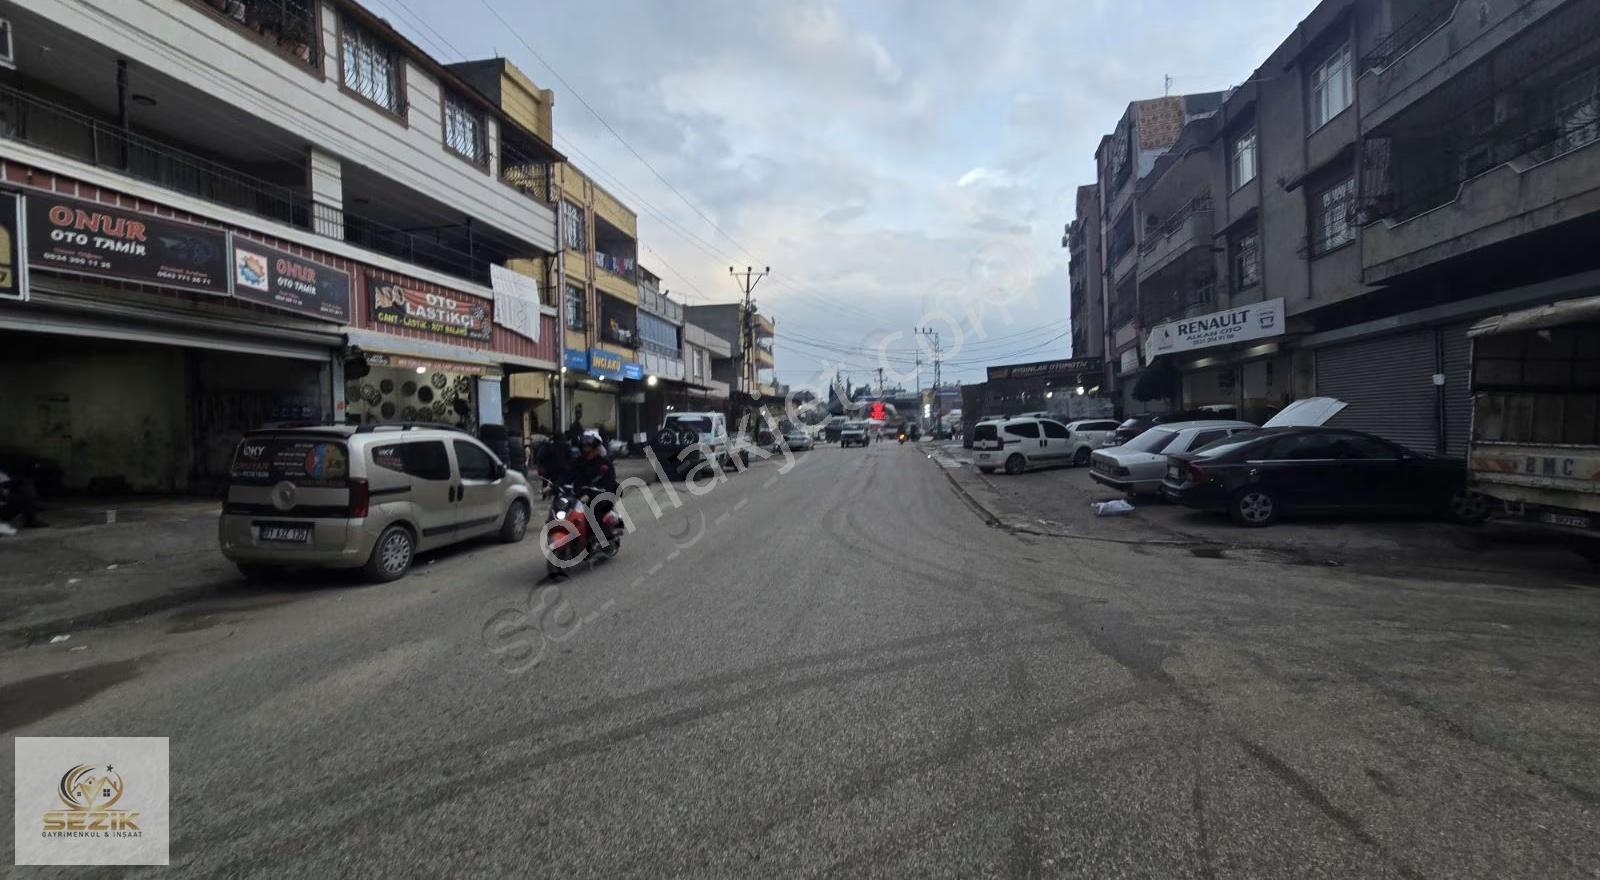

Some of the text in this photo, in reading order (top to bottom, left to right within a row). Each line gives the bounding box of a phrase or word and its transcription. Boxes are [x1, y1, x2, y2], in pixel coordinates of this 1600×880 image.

[49, 205, 147, 241] ONUR
[51, 229, 88, 245] OTO
[93, 236, 146, 256] TAMİR
[276, 259, 316, 284] ONUR
[277, 276, 293, 289] OTO
[426, 293, 457, 310] OTO
[1178, 309, 1251, 336] RENAULT
[1220, 326, 1243, 336] OTO
